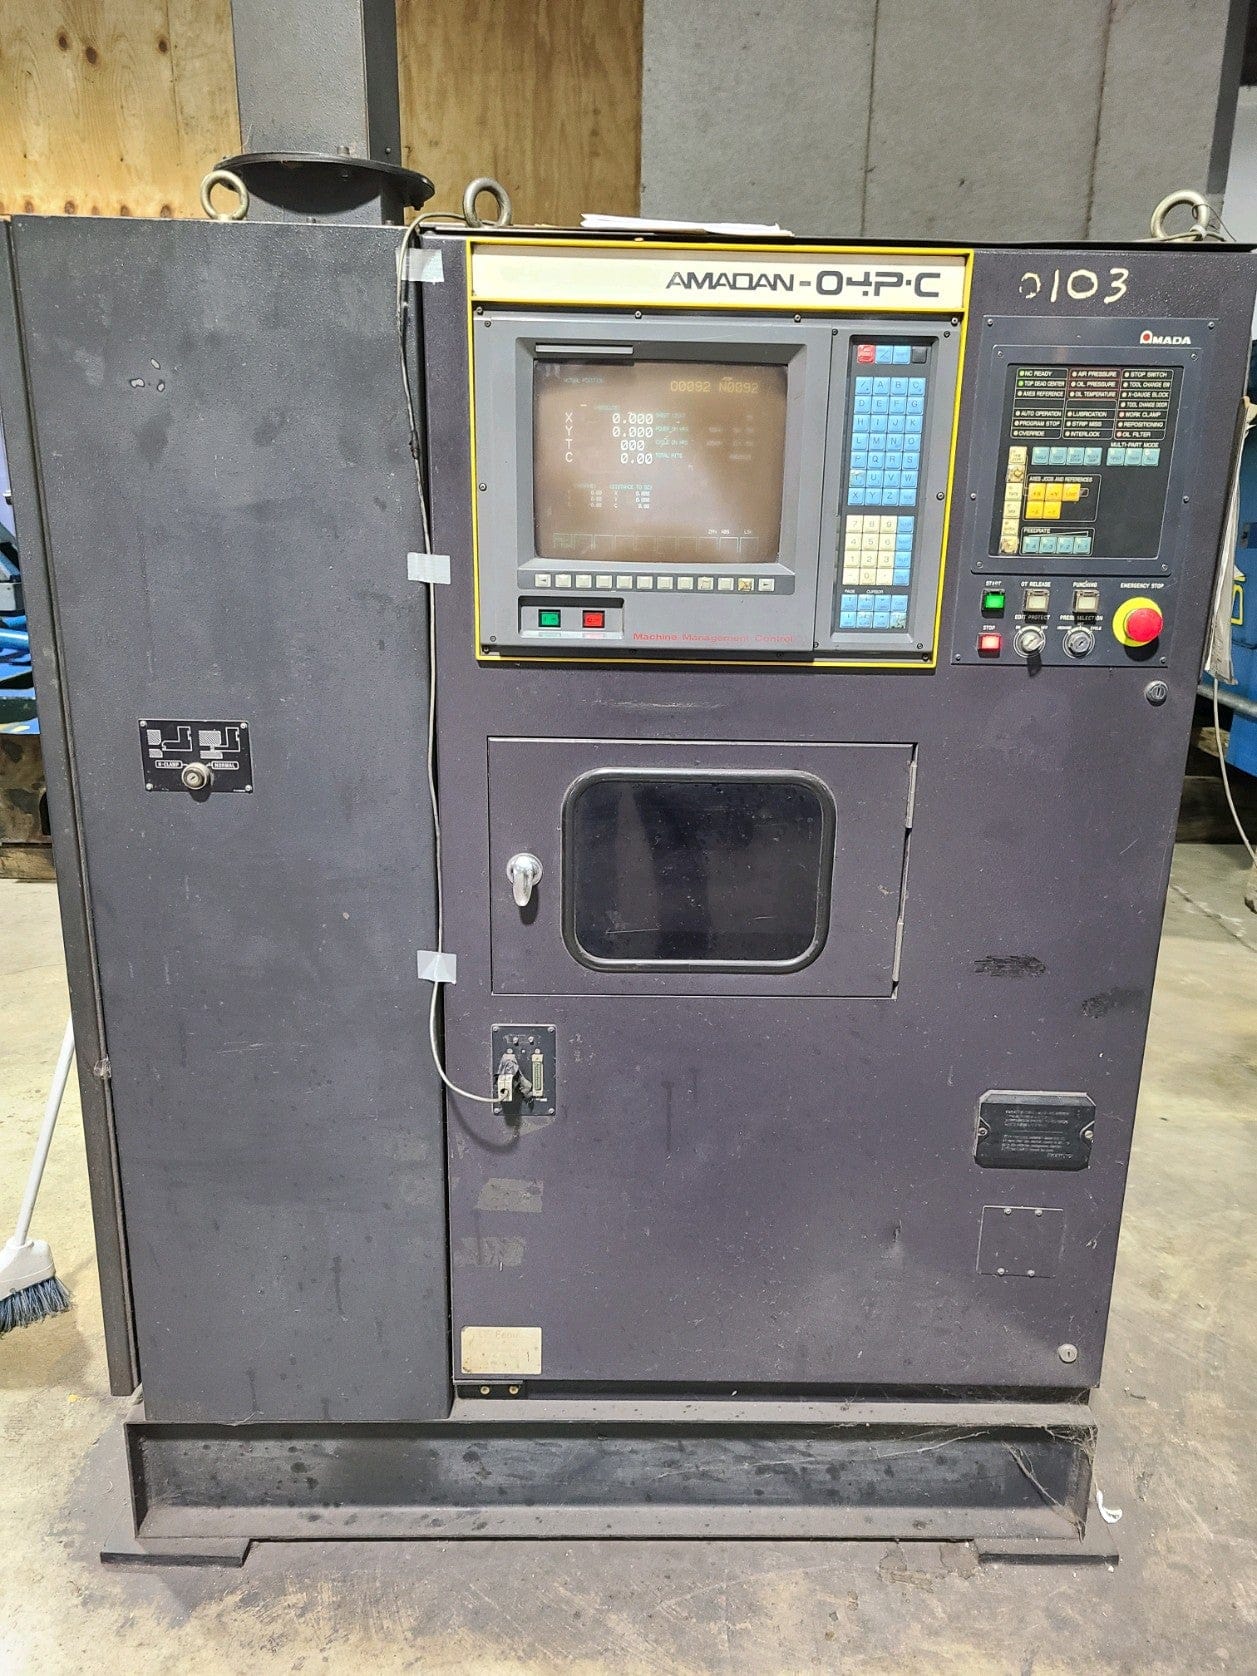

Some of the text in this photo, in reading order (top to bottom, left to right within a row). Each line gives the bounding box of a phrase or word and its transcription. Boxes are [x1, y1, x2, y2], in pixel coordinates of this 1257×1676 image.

[1019, 268, 1129, 303] 0103
[1140, 330, 1191, 344] AMADA
[565, 412, 573, 423] X
[612, 413, 653, 424] 0.000
[565, 426, 653, 437] Y 0.000
[565, 439, 645, 451] T 000
[565, 452, 653, 464] C 0.00
[632, 632, 793, 643] Machine Management Control
